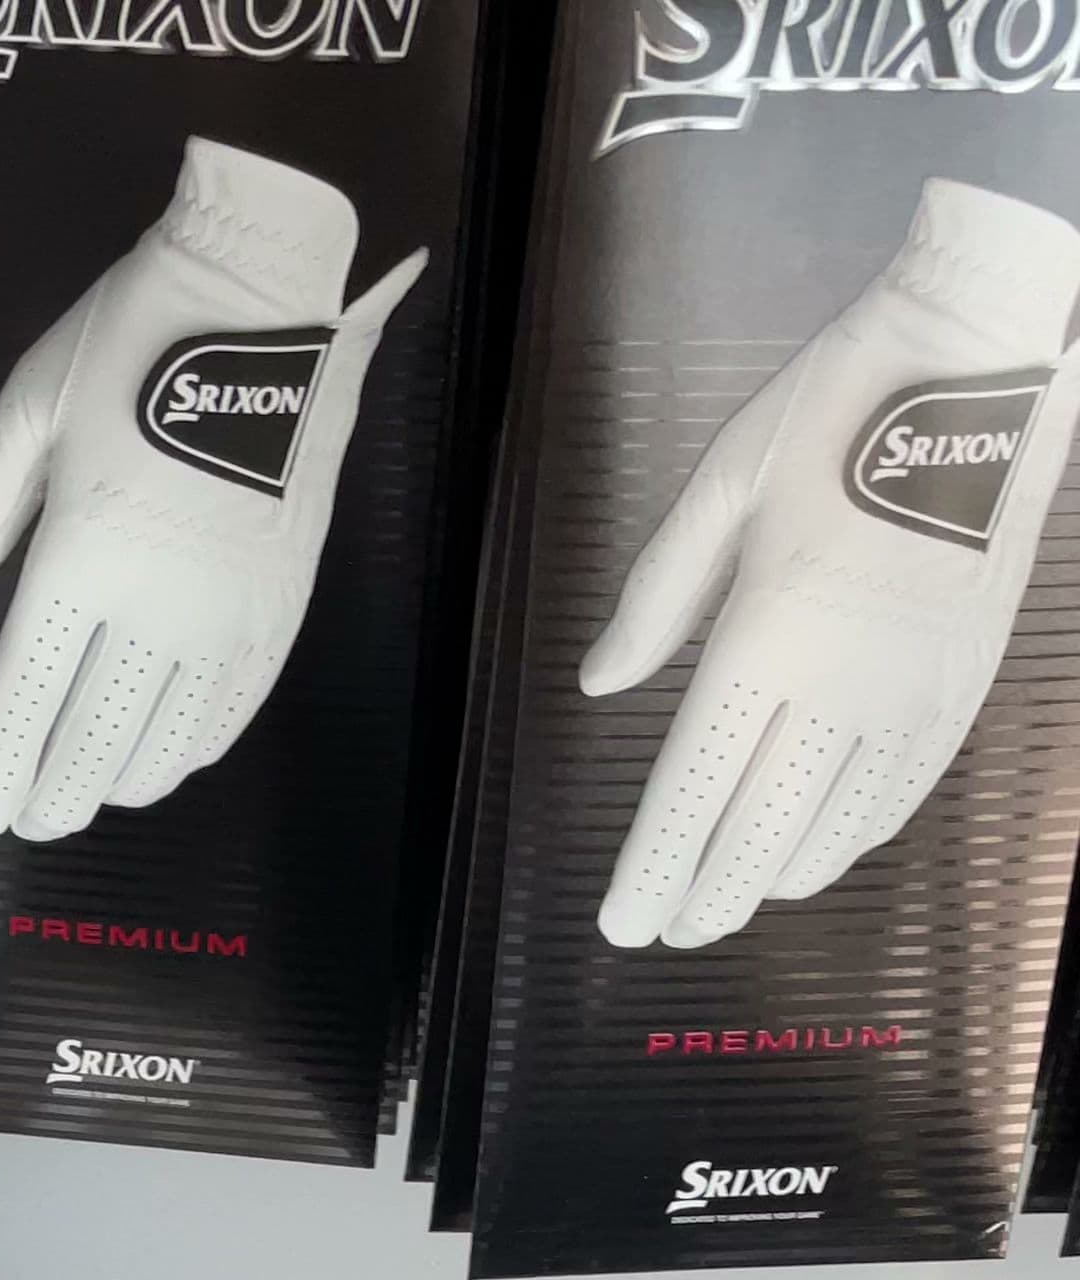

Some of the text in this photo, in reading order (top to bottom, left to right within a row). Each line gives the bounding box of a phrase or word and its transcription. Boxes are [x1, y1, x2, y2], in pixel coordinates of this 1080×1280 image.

[593, 0, 1080, 160] SRIXO
[162, 373, 307, 425] SRIXON
[870, 427, 1020, 482] SRIXON
[9, 916, 248, 957] PREMIUM
[46, 1039, 197, 1084] SRIXON
[647, 1025, 902, 1055] PREMIUM
[665, 1161, 834, 1214] SRIXON
